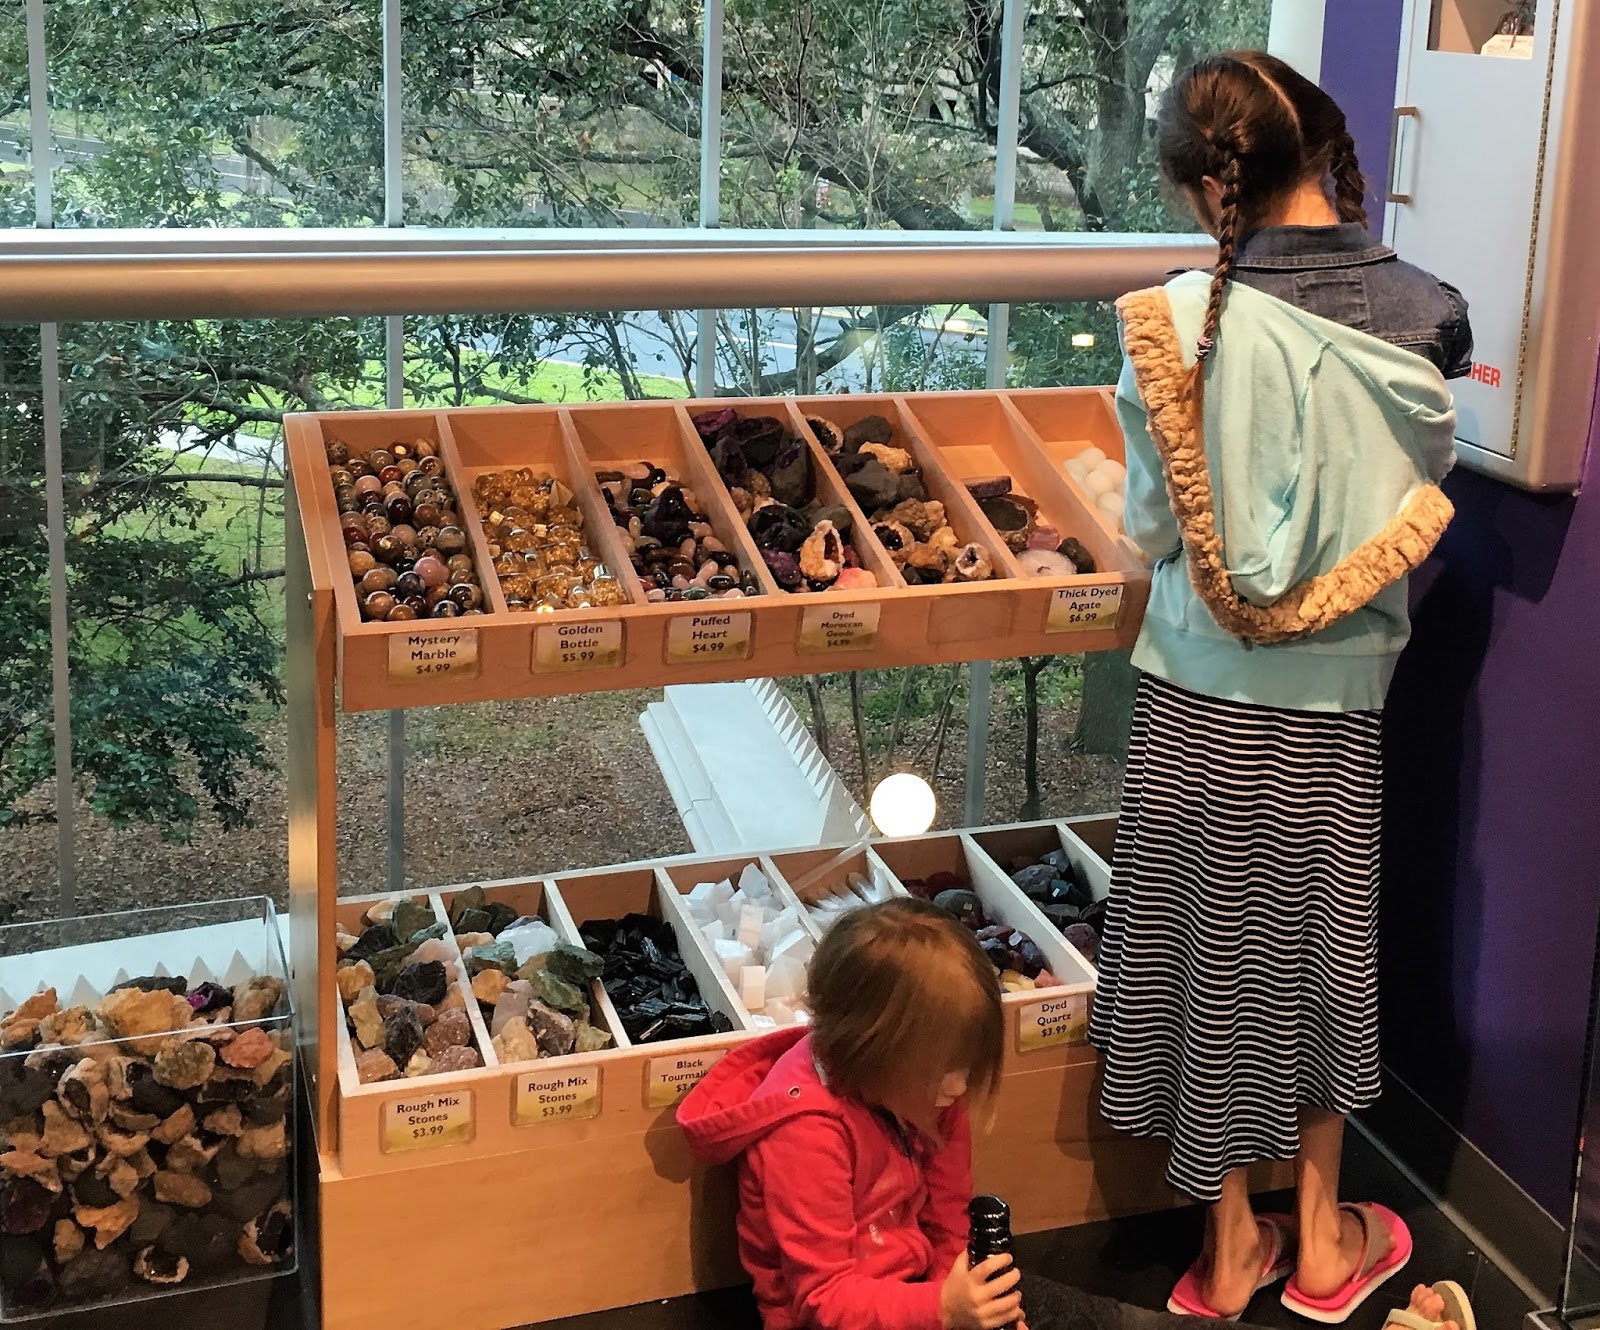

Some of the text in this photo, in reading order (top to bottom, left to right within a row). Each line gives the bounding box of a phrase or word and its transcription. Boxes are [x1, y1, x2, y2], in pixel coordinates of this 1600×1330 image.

[1465, 361, 1501, 388] HER
[1058, 587, 1119, 598] Thick Dyed
[1069, 601, 1101, 612] Agate
[692, 616, 731, 626] Puffed
[832, 611, 855, 620] Dyed
[1069, 613, 1097, 623] $6.99
[558, 624, 603, 636] Golden
[821, 621, 863, 629] Moroccan
[408, 634, 460, 647] Mystery
[692, 630, 728, 640] Heart
[560, 638, 599, 650] Bottle
[693, 642, 724, 653] $4.99
[827, 639, 850, 648] $4.99
[411, 649, 457, 661] Marble
[562, 651, 595, 662] $5.99
[415, 663, 451, 674] $4.99
[1041, 1001, 1067, 1013] Dyed
[1037, 1013, 1071, 1026] Quartz
[1041, 1024, 1067, 1037] $3.99
[676, 1059, 703, 1069] Black
[661, 1069, 708, 1082] Tourmali
[528, 1076, 588, 1092] Rough Mix
[538, 1093, 577, 1104] Stones
[397, 1097, 460, 1113] Rough Mix
[542, 1104, 572, 1117] $3.99
[408, 1113, 449, 1125] Stones
[412, 1125, 444, 1139] $3.99
